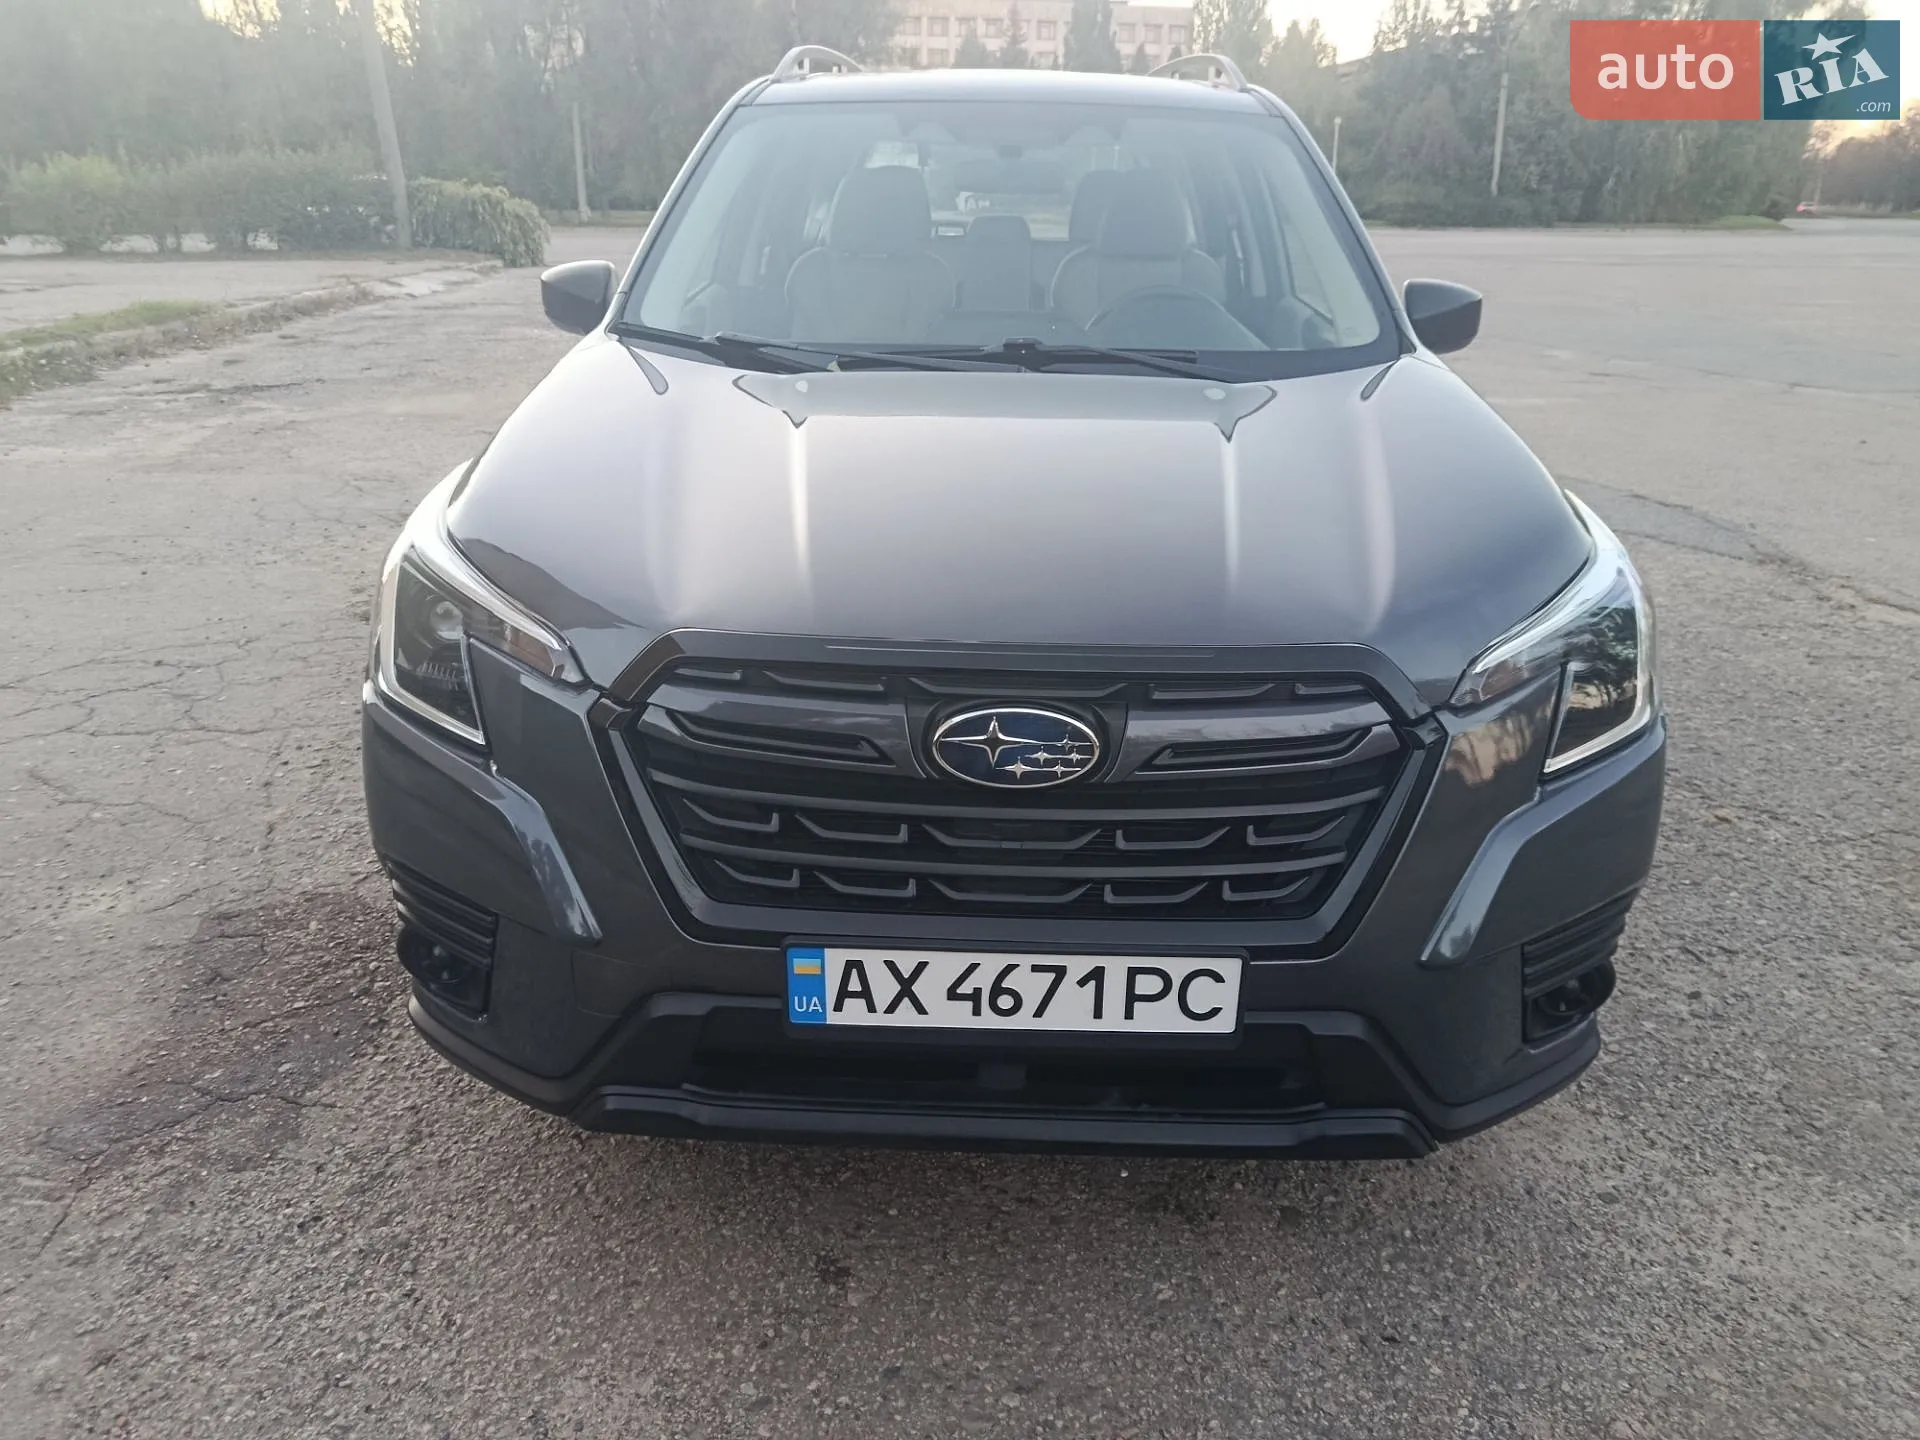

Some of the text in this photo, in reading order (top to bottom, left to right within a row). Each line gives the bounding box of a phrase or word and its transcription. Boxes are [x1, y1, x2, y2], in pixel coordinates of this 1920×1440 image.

[793, 995, 823, 1014] UA
[832, 959, 1227, 1021] AX 4671 PC
